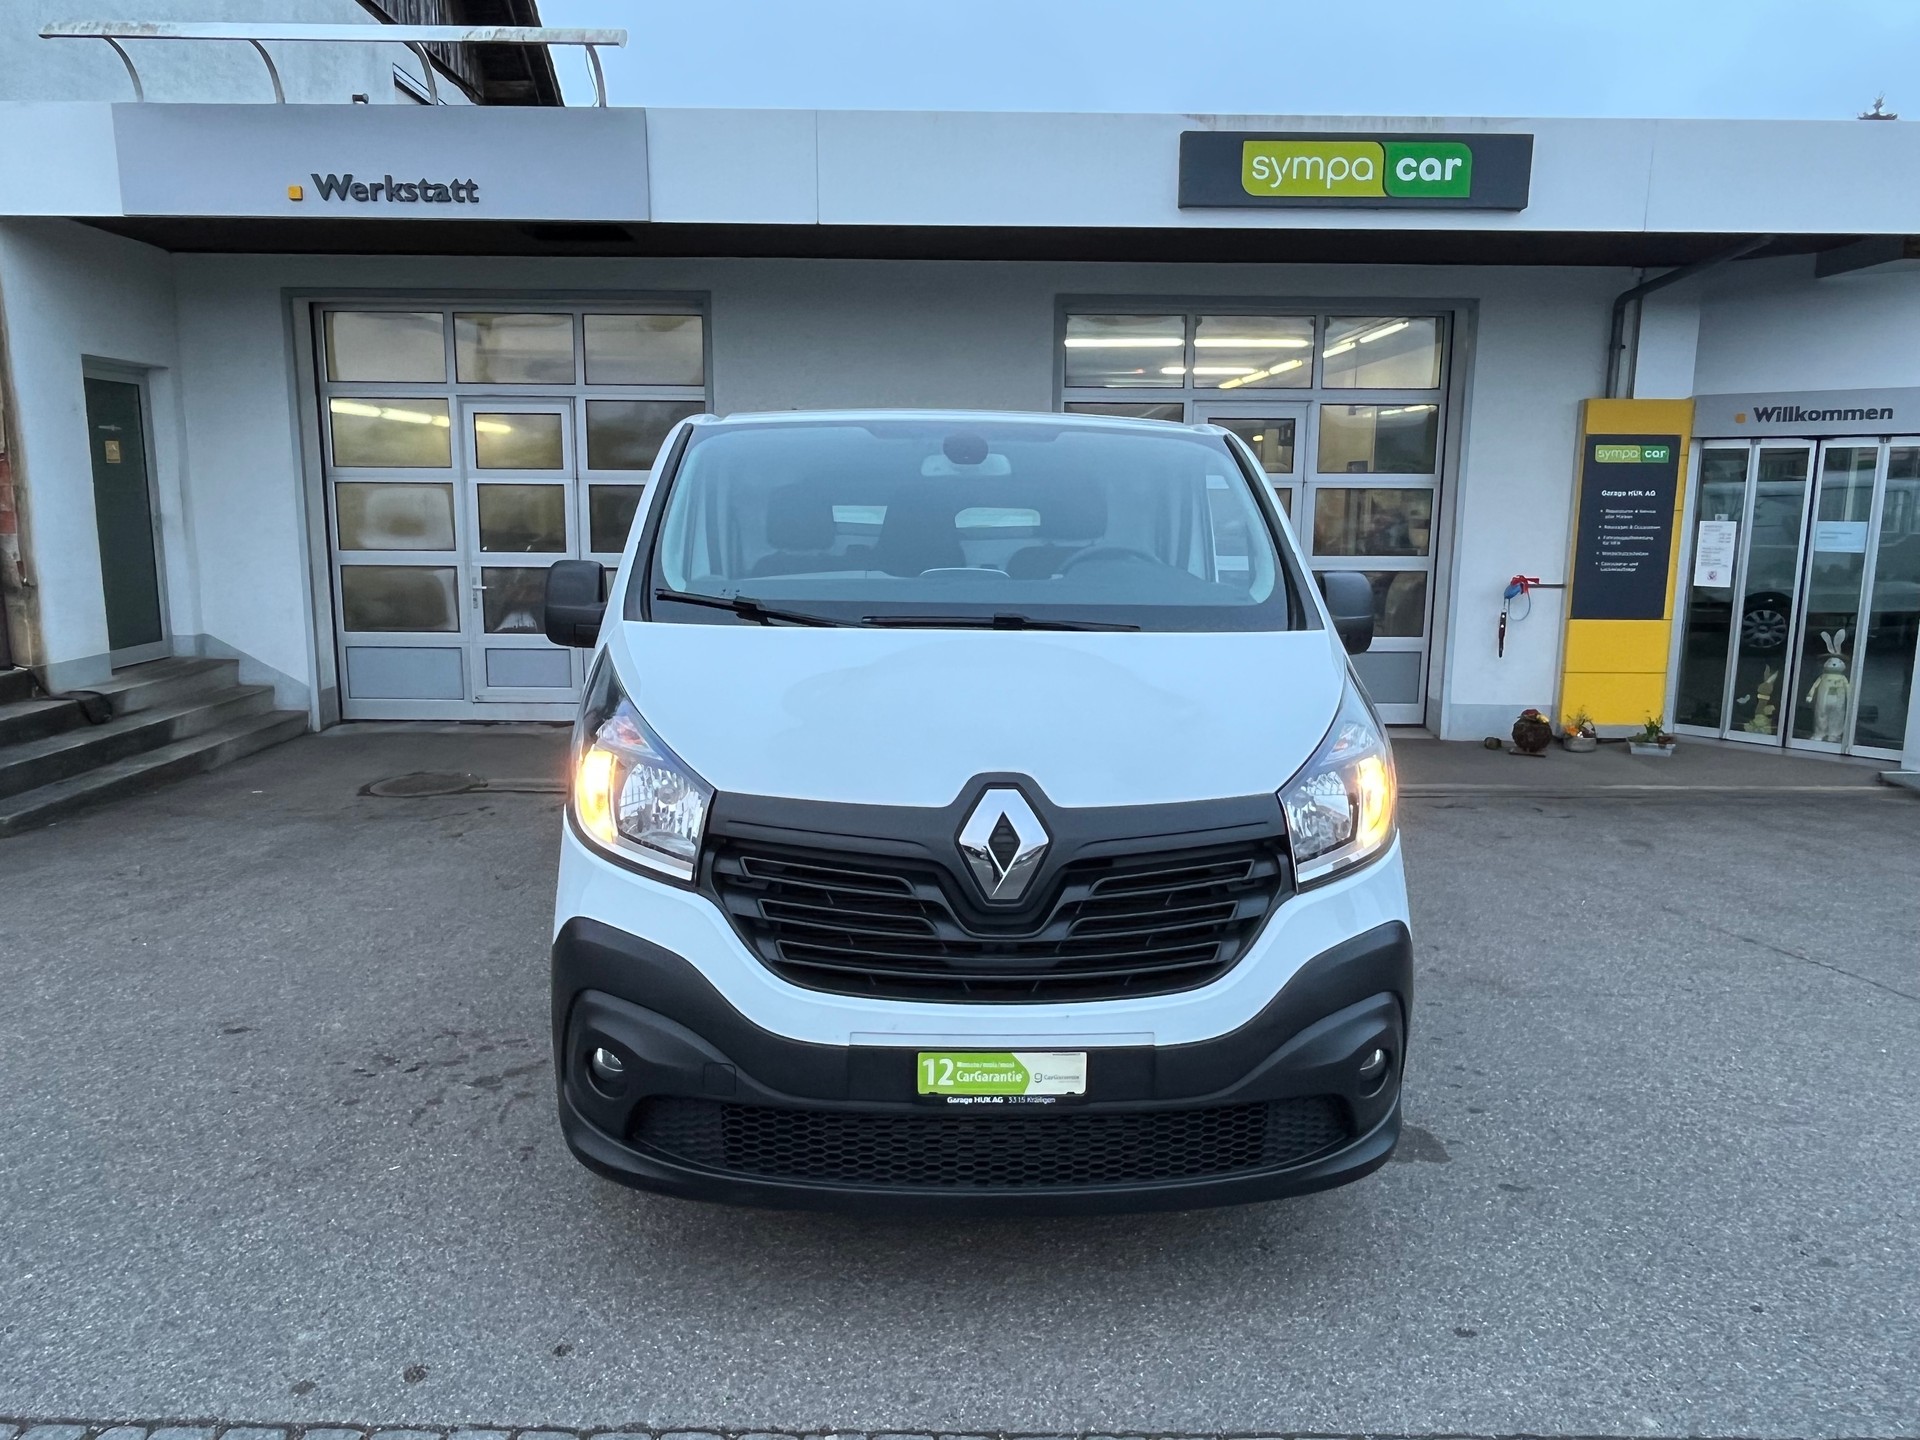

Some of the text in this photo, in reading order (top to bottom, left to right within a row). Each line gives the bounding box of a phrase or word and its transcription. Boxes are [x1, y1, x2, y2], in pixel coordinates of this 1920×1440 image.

[1251, 155, 1463, 189] sympa car
[310, 173, 480, 204] Werkstatt
[1753, 405, 1894, 423] Willkommen
[1598, 449, 1667, 461] sympa car
[1601, 489, 1627, 497] Garage
[922, 1058, 955, 1086] 12
[956, 1070, 1024, 1083] CarGarantie
[947, 1096, 973, 1105] Garage
[992, 1096, 1004, 1104] AG
